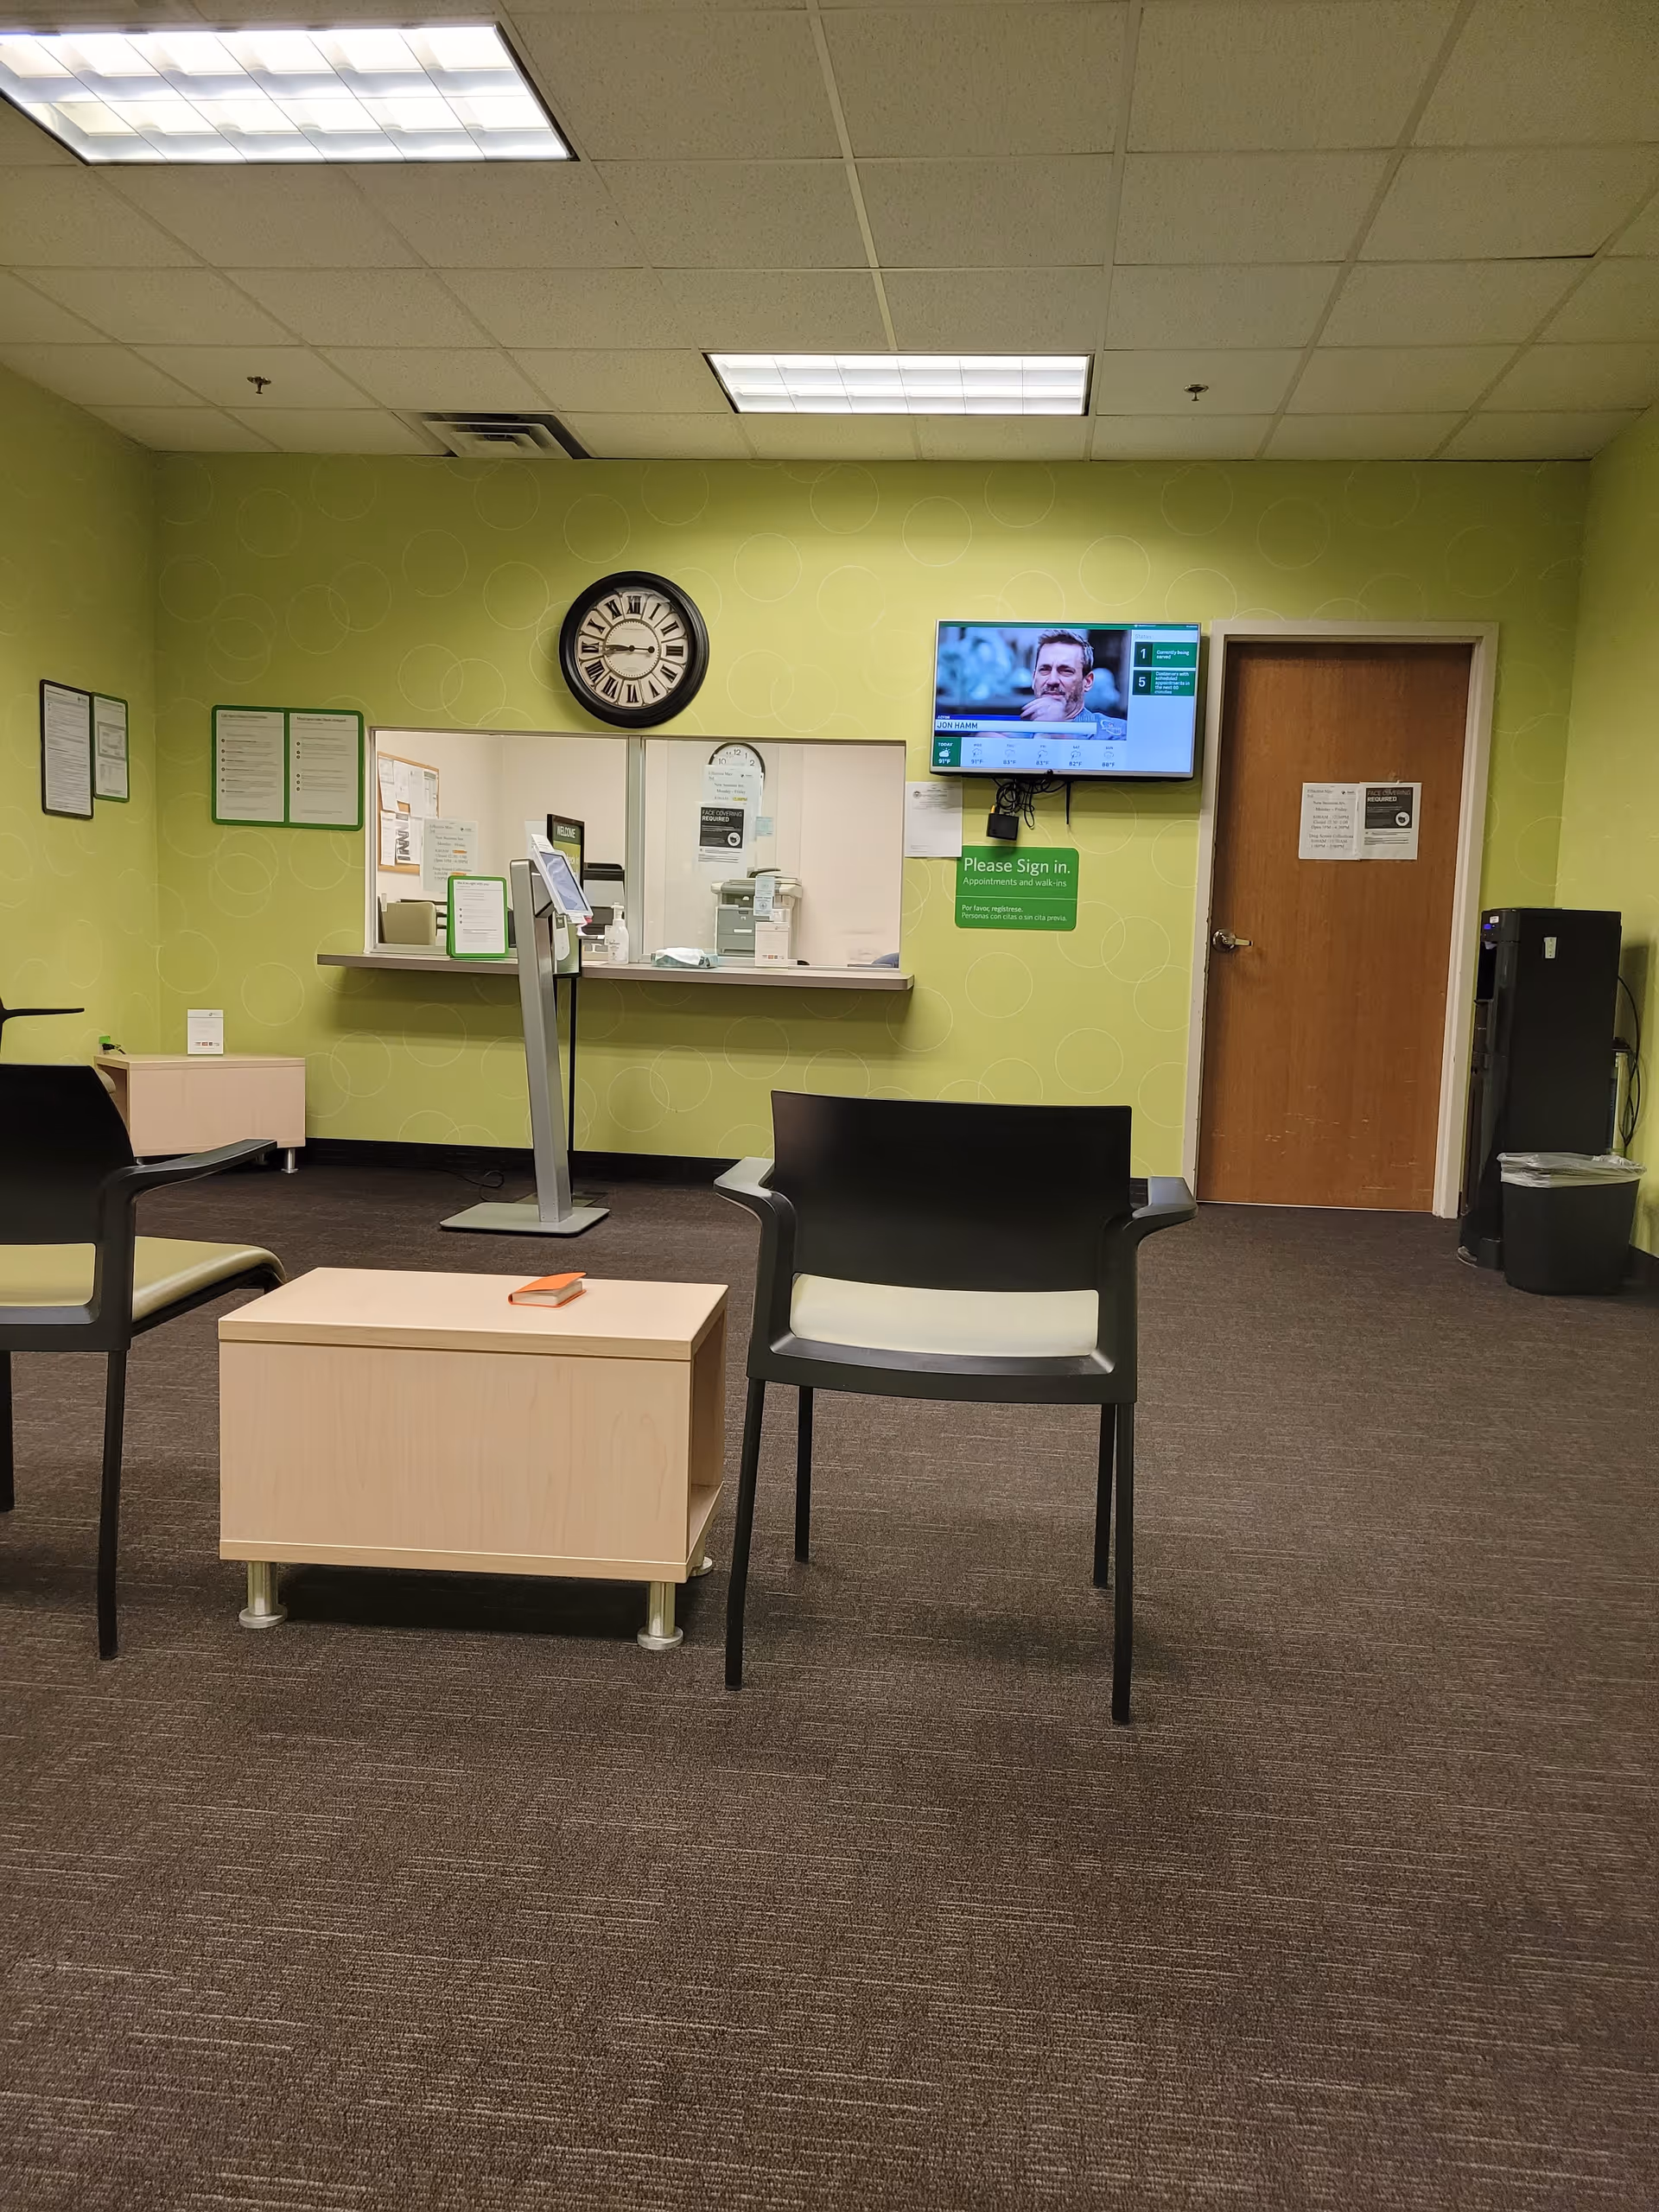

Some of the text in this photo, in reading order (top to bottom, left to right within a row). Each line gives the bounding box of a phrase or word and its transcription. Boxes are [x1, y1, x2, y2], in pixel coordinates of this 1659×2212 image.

[1141, 648, 1146, 659] 1
[1138, 677, 1146, 687] 5
[556, 826, 575, 838] WELCOME
[964, 857, 1071, 876] Please Sign in.
[963, 877, 1017, 887] Appointments
[1035, 879, 1066, 887] walk-ins
